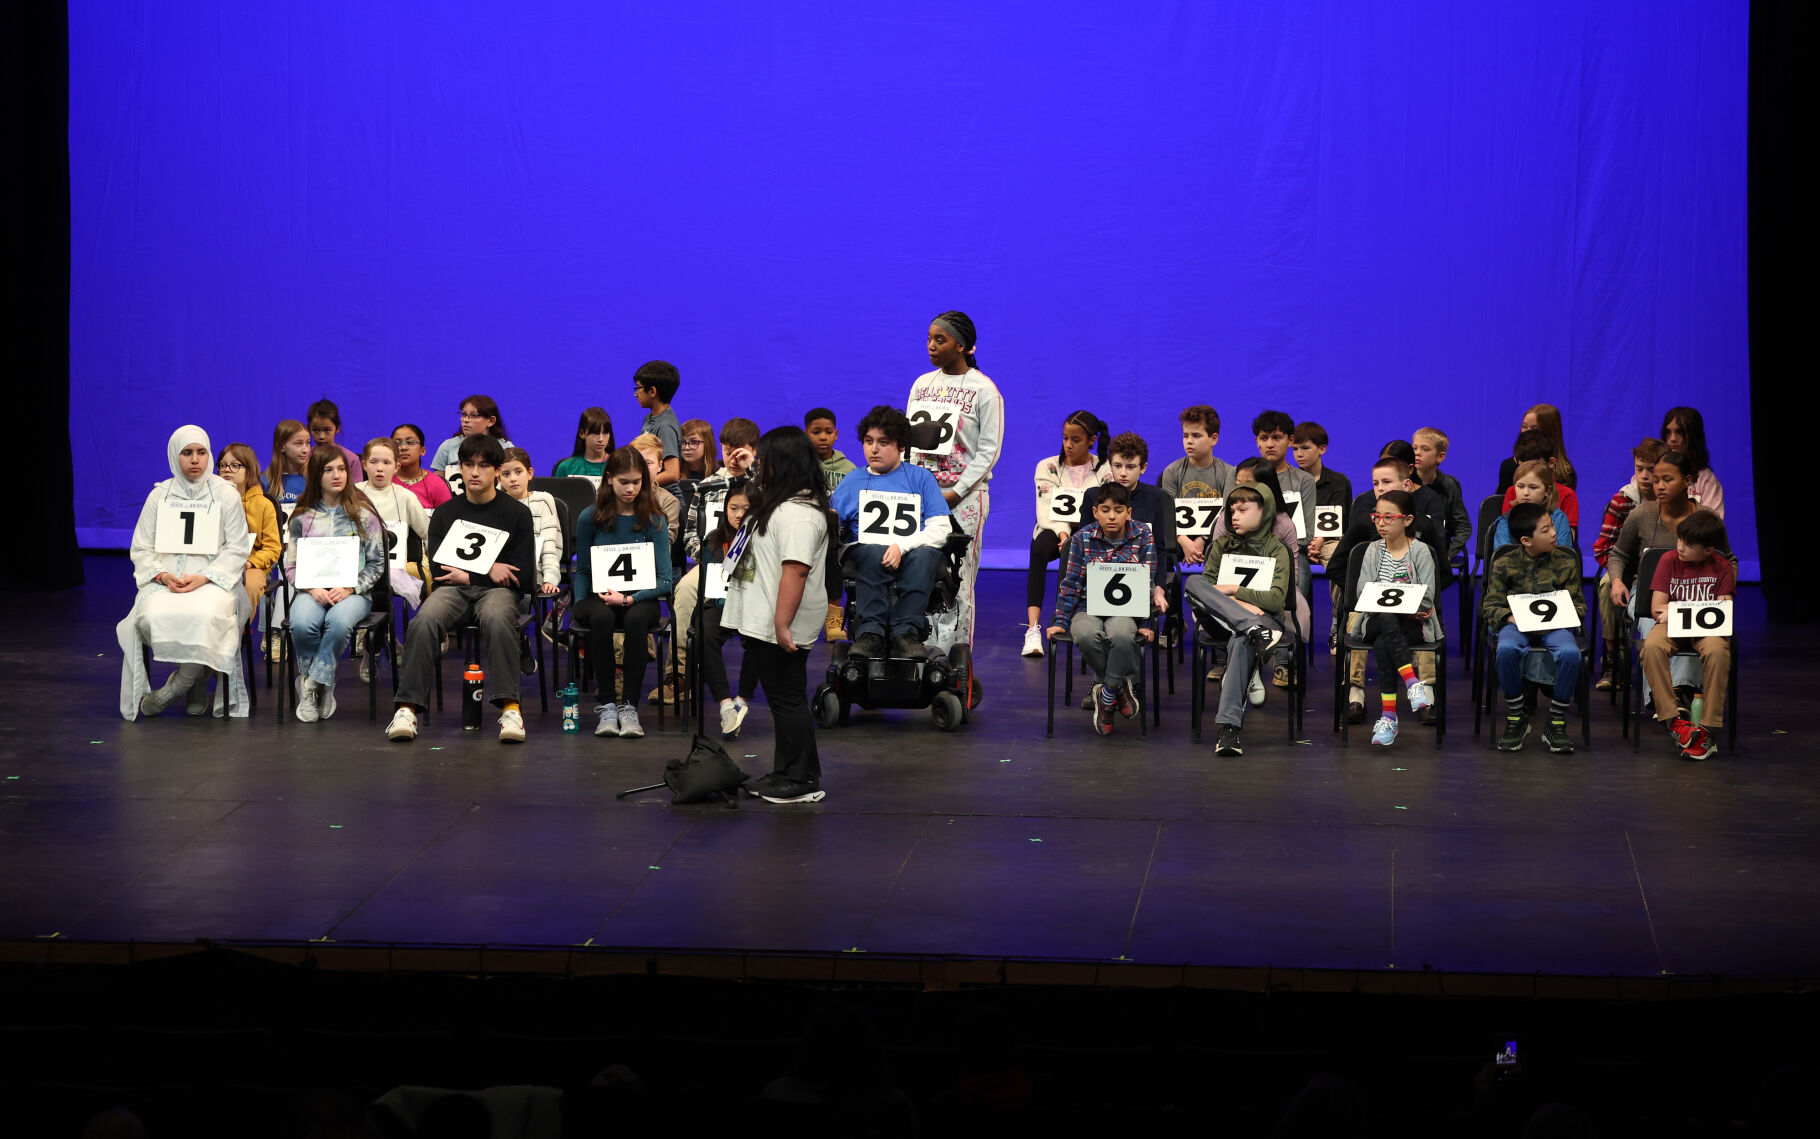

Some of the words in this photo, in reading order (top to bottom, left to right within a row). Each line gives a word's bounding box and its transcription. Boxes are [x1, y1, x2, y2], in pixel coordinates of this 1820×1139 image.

[946, 387, 976, 402] KITTY
[1052, 494, 1077, 515] 3
[180, 512, 195, 544] 1
[863, 500, 918, 537] 25
[1175, 506, 1222, 528] 37
[1316, 512, 1340, 531] 8
[456, 532, 486, 561] 3
[727, 524, 750, 563] 24
[608, 553, 637, 582] 4
[1234, 566, 1260, 588] 7
[1104, 573, 1132, 606] 6
[1377, 588, 1405, 607] 8
[1669, 583, 1716, 601] YOUNG
[1529, 599, 1557, 623] 9
[1677, 606, 1725, 630] 10
